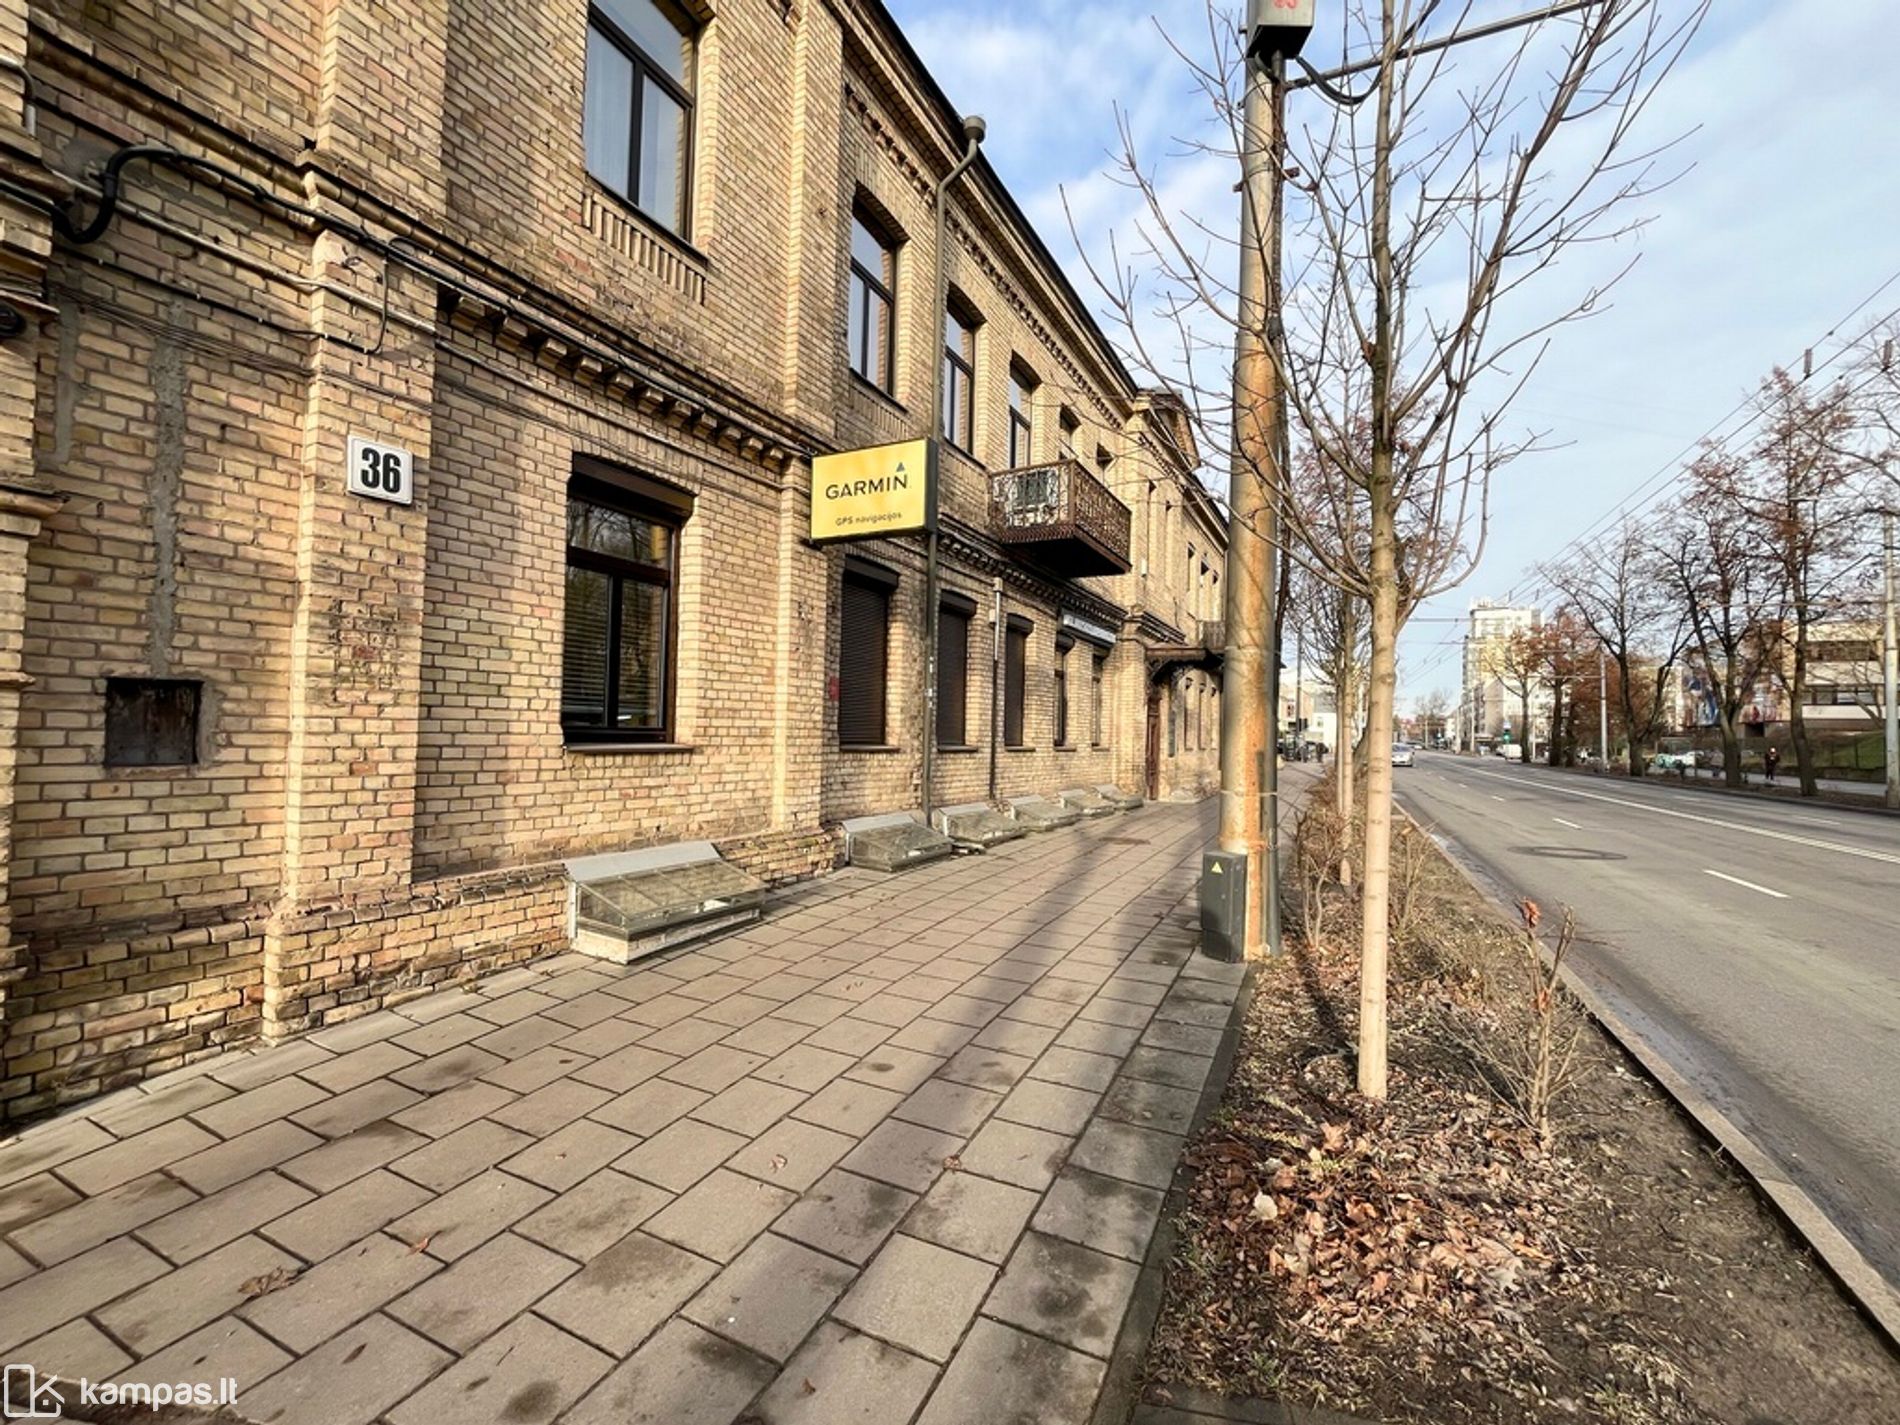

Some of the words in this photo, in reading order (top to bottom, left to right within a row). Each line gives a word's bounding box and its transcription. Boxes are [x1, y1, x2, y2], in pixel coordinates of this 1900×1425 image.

[361, 447, 401, 494] 36
[825, 474, 908, 500] GARMIN
[835, 515, 853, 526] GPS
